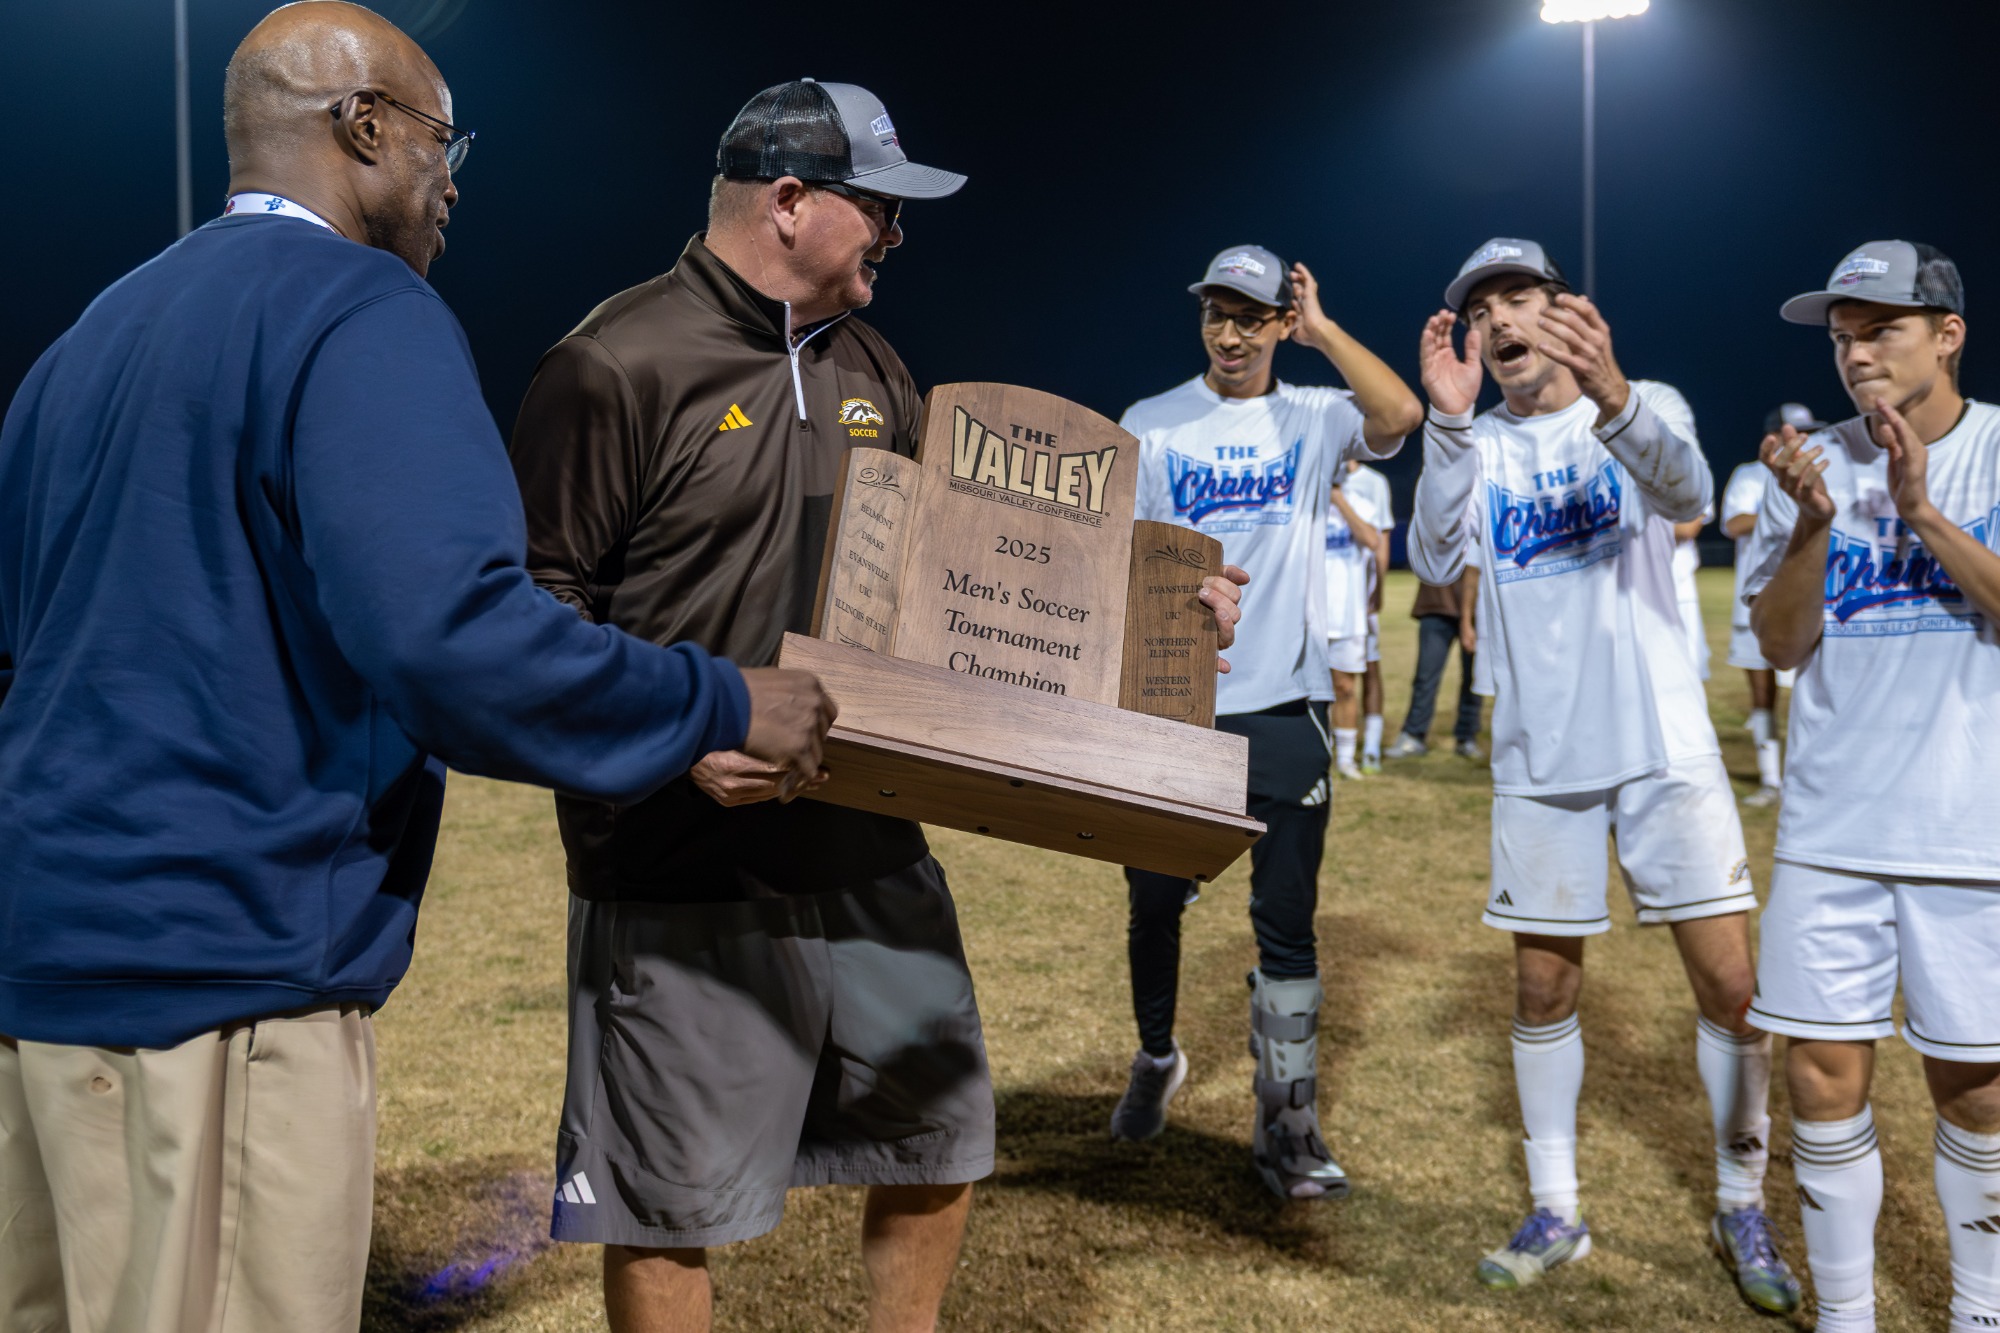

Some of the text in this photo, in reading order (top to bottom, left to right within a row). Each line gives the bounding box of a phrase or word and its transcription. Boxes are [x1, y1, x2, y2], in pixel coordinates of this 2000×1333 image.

[849, 428, 878, 438] SOCCER
[1009, 423, 1058, 449] THE
[951, 405, 1118, 514] VALLEY
[1215, 445, 1260, 460] THE
[1532, 464, 1580, 492] THE
[950, 481, 1102, 527] MISSOURI VALLEY CONFERENCE
[860, 503, 894, 530] BELMONT
[861, 530, 885, 552] DRAKE
[994, 535, 1051, 565] 2025
[849, 550, 890, 581] EVANSVILLE
[859, 584, 872, 599] UIC
[942, 569, 1090, 623] Men's Soccer
[1148, 584, 1203, 595] EVANSVILLE
[835, 597, 887, 636] ILLINOIS STATE
[1165, 611, 1181, 620] UIC
[945, 608, 1082, 661] Tournament
[1144, 637, 1198, 647] NORTHERN
[1150, 649, 1190, 658] ILLINOIS
[1141, 687, 1192, 697] MICHIGAN
[1145, 676, 1191, 685] WESTERN
